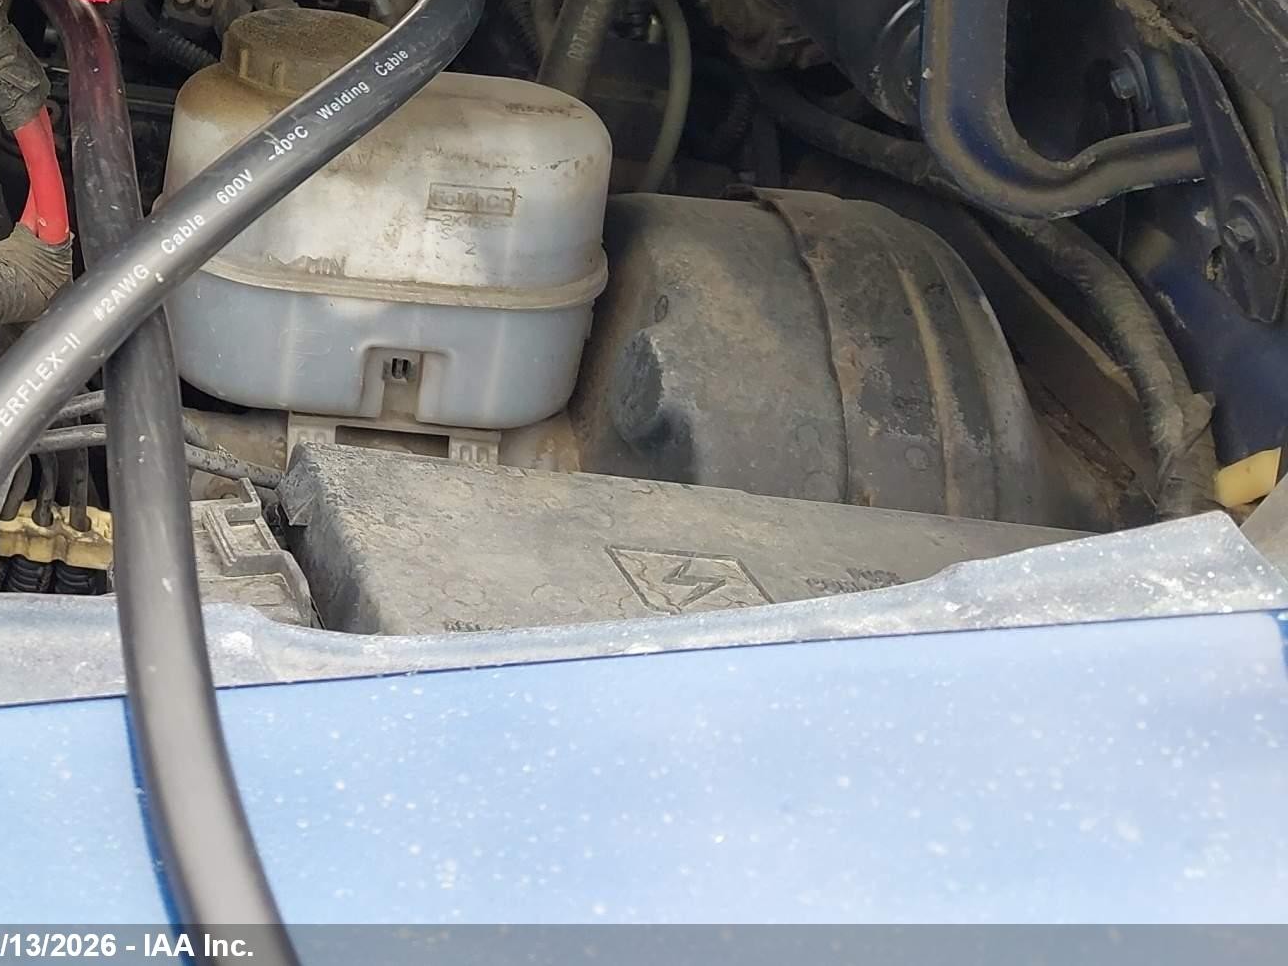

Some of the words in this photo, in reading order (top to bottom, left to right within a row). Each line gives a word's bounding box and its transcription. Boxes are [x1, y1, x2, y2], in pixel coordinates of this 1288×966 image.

[92, 263, 150, 323] #2AWG
[160, 212, 206, 256] Cable
[215, 168, 255, 205] 600V
[315, 80, 371, 121] Welding
[374, 48, 410, 78] Cable
